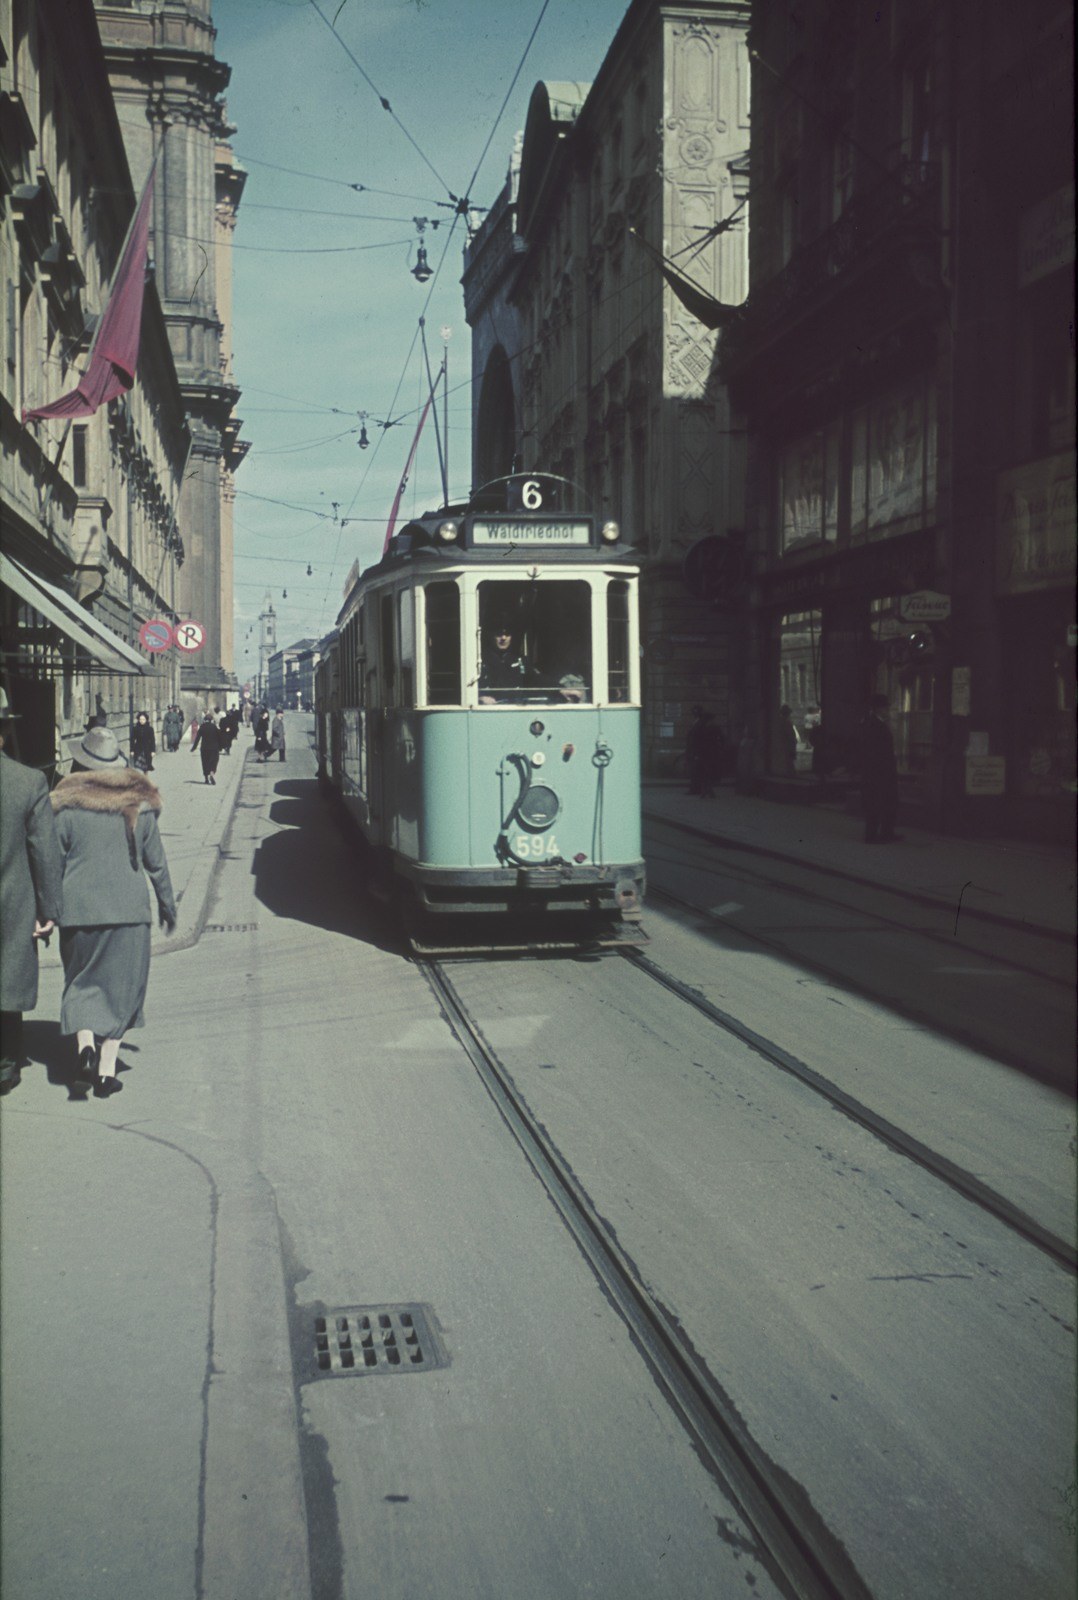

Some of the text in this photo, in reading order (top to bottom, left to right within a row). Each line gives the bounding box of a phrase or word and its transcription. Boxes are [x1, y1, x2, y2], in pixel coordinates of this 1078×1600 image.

[521, 481, 543, 510] 6
[487, 523, 574, 539] Waldfriedhof
[516, 835, 560, 857] 594
